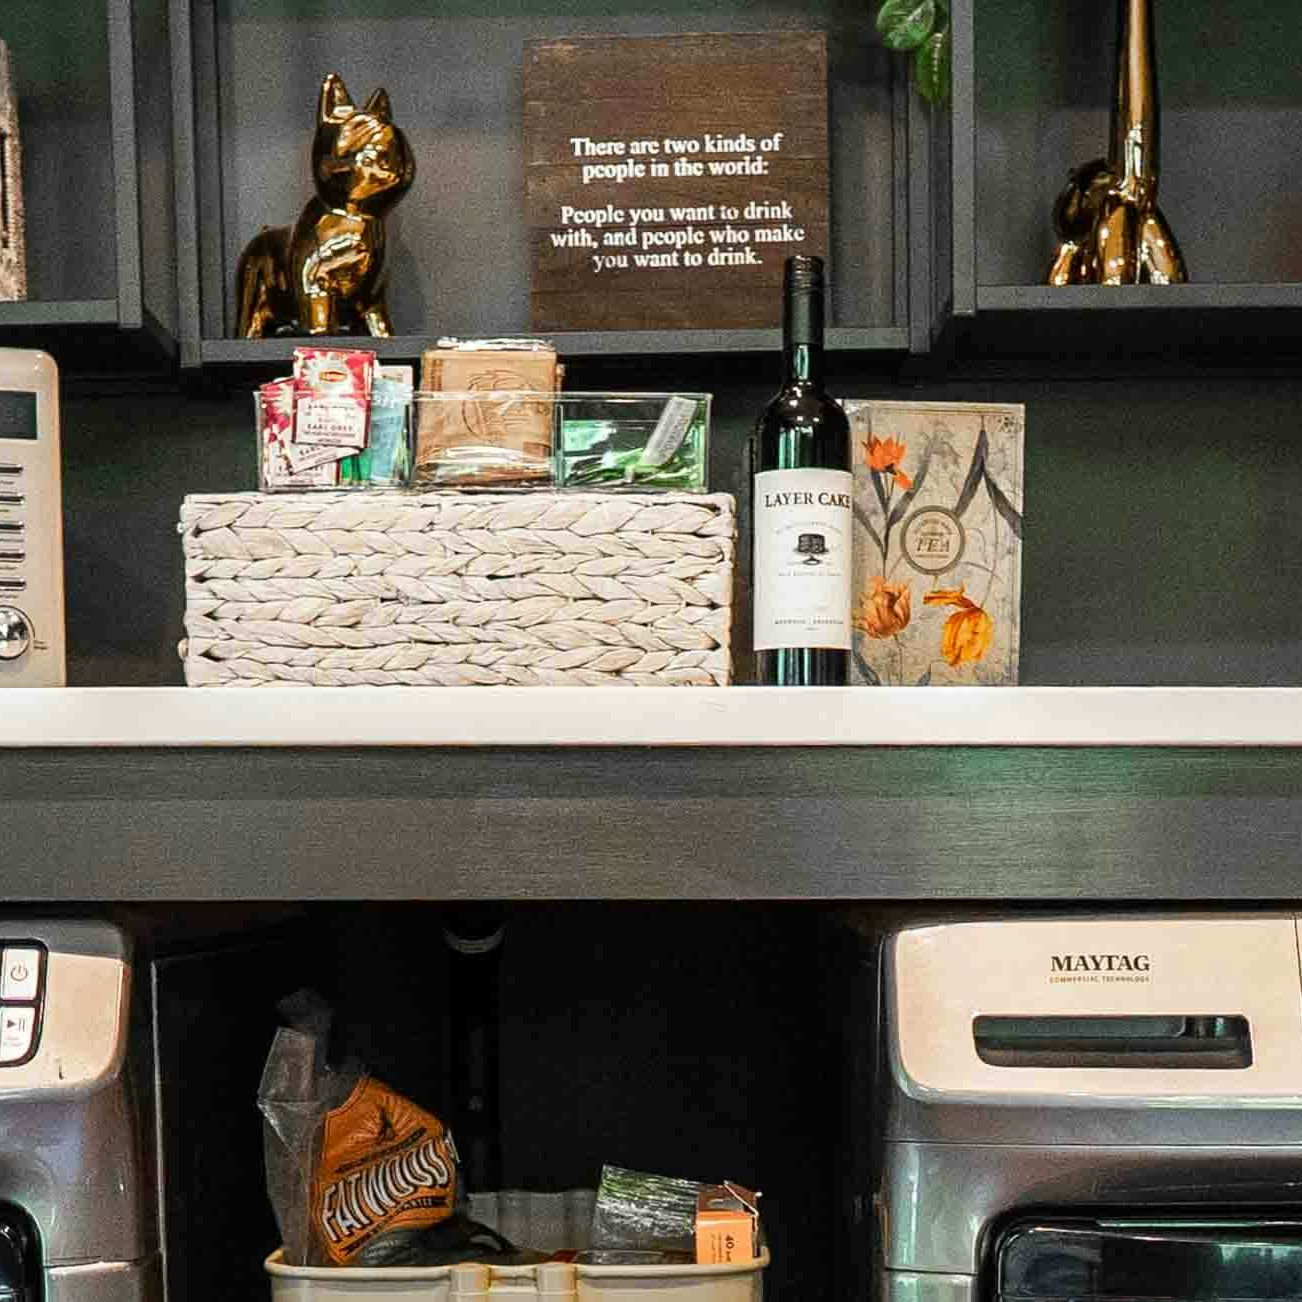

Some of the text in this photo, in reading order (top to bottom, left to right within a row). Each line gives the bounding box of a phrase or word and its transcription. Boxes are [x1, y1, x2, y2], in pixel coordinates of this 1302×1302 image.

[571, 133, 784, 156] There are two kinds of
[583, 156, 769, 184] people in the world:
[561, 201, 793, 227] People you want to drink
[550, 224, 805, 250] with, and people who make
[593, 247, 763, 273] you want to drink.
[765, 492, 813, 508] LAYER
[1050, 954, 1150, 971] MAYTAG
